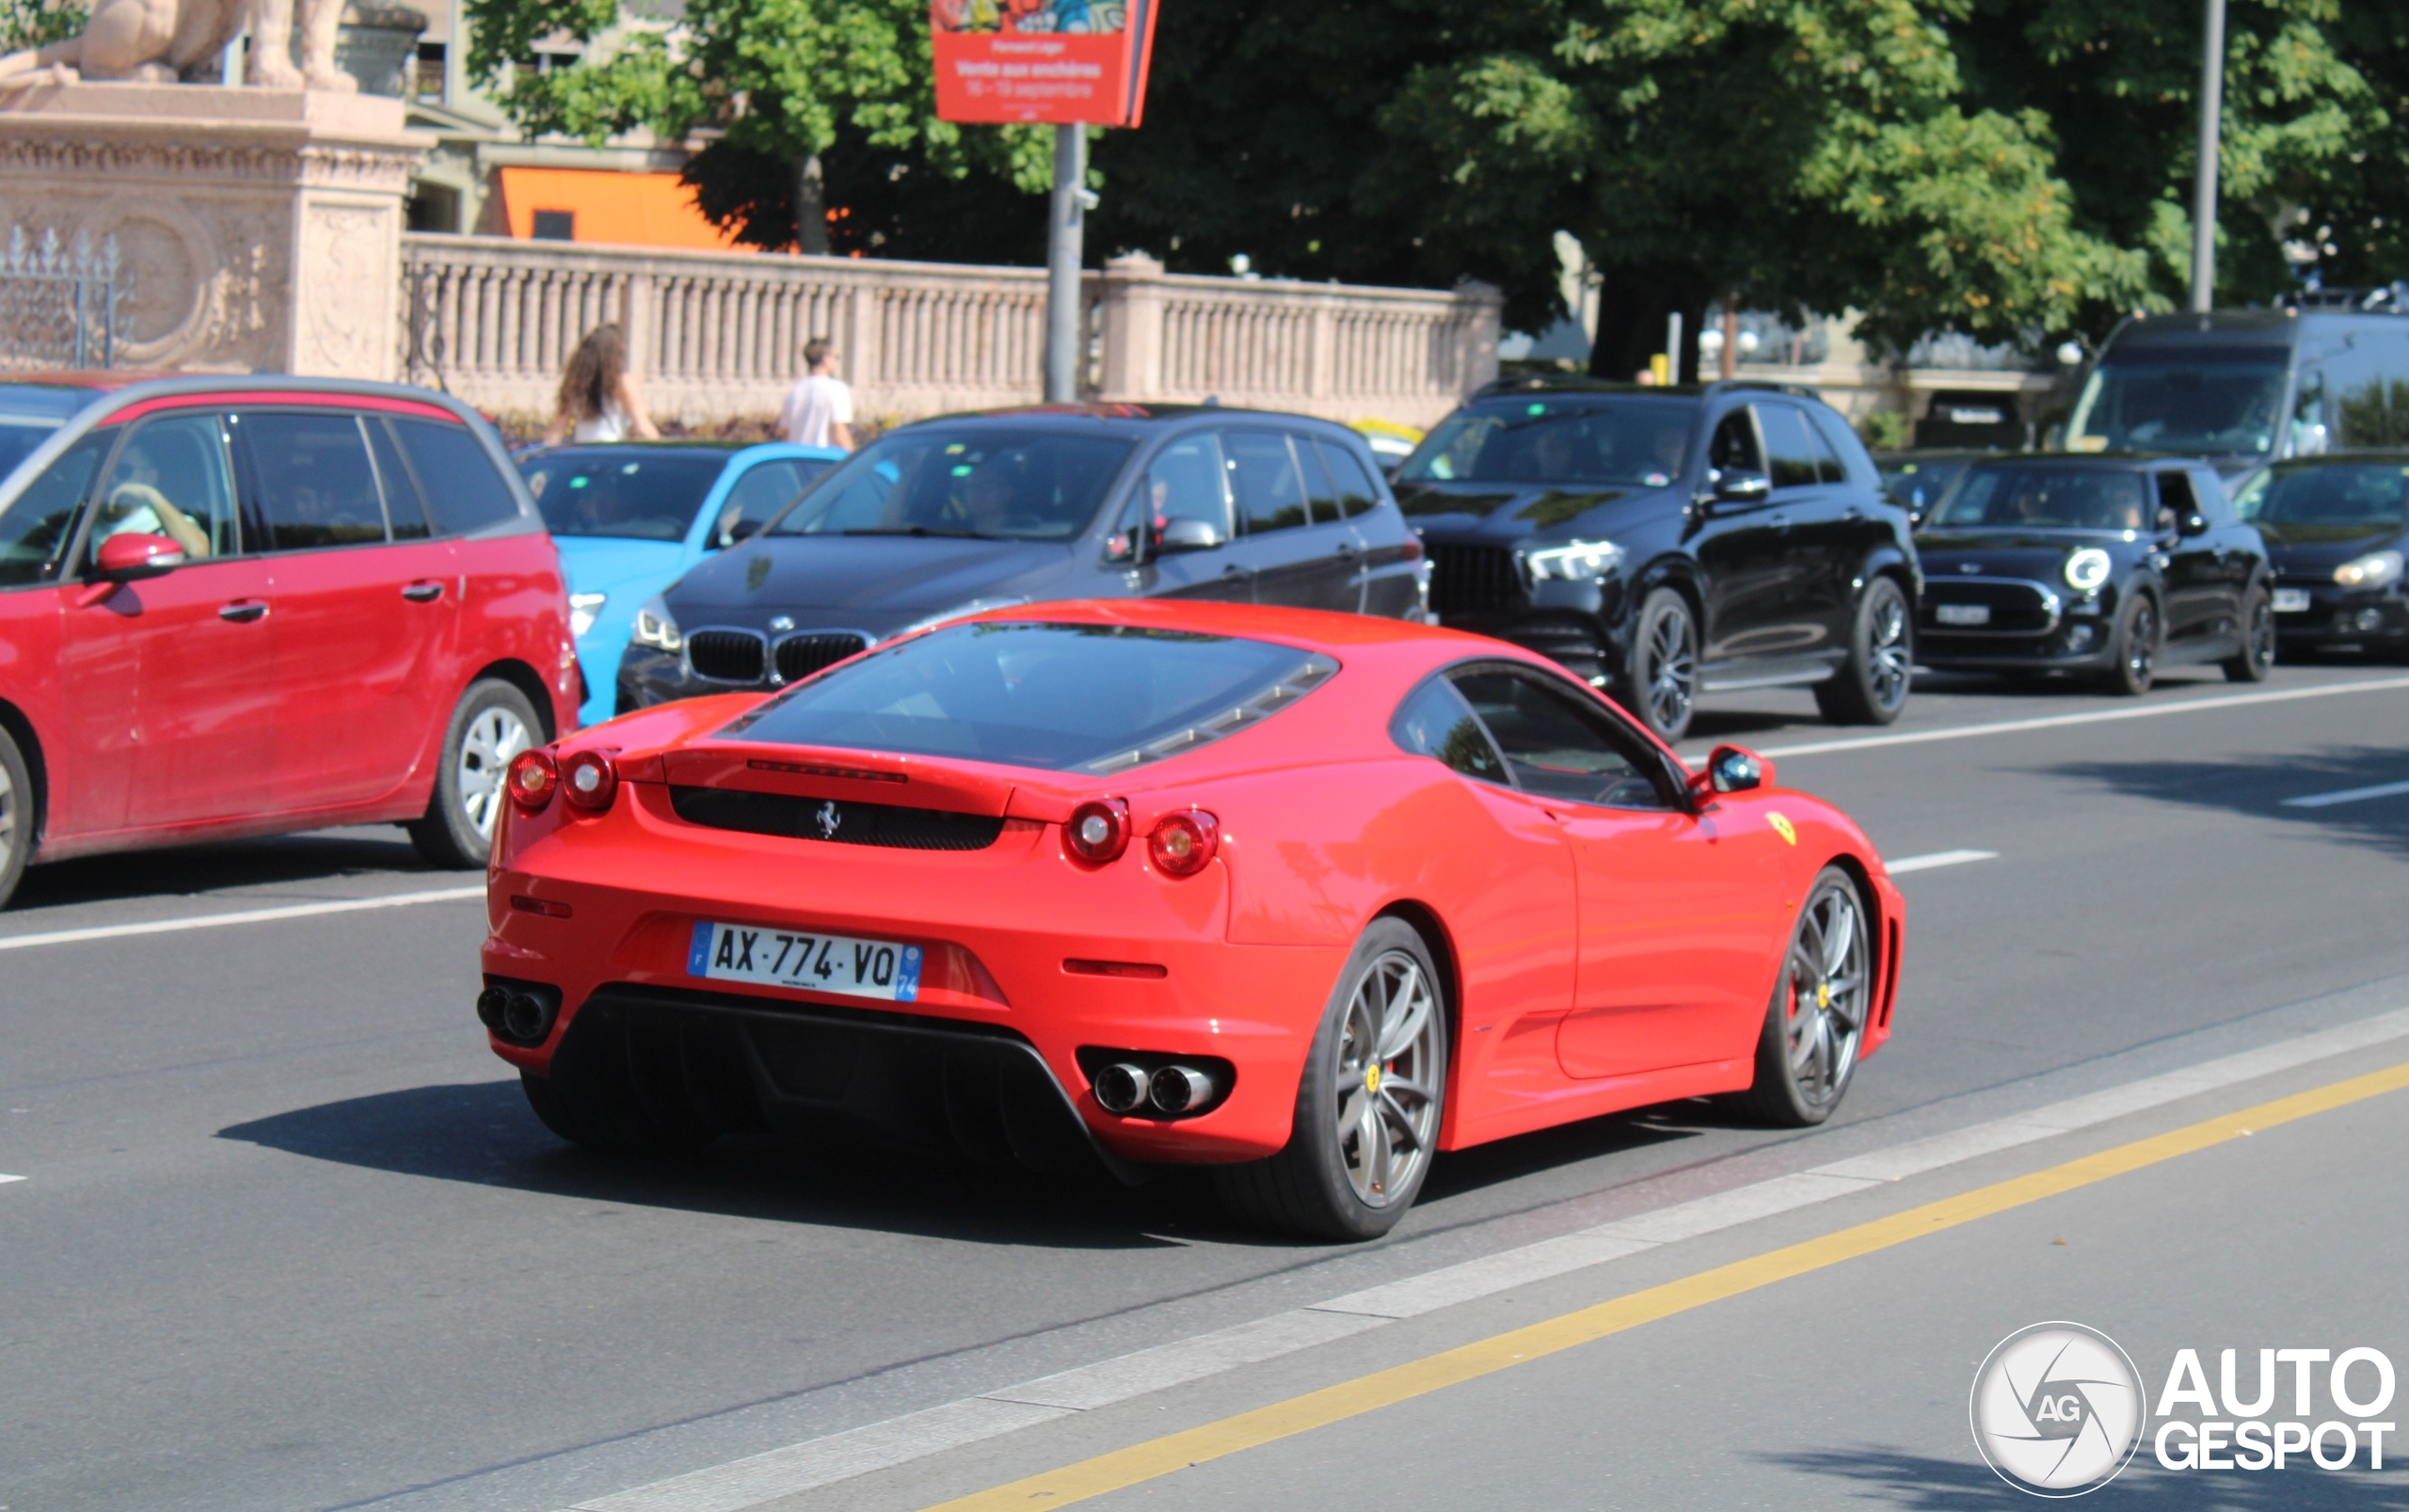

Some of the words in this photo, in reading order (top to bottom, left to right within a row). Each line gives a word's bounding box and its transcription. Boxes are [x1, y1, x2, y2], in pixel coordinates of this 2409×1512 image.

[955, 59, 999, 77] Vente
[1001, 63, 1029, 78] aux
[1014, 82, 1093, 99] septembre
[694, 954, 703, 966] F
[899, 975, 917, 995] 74
